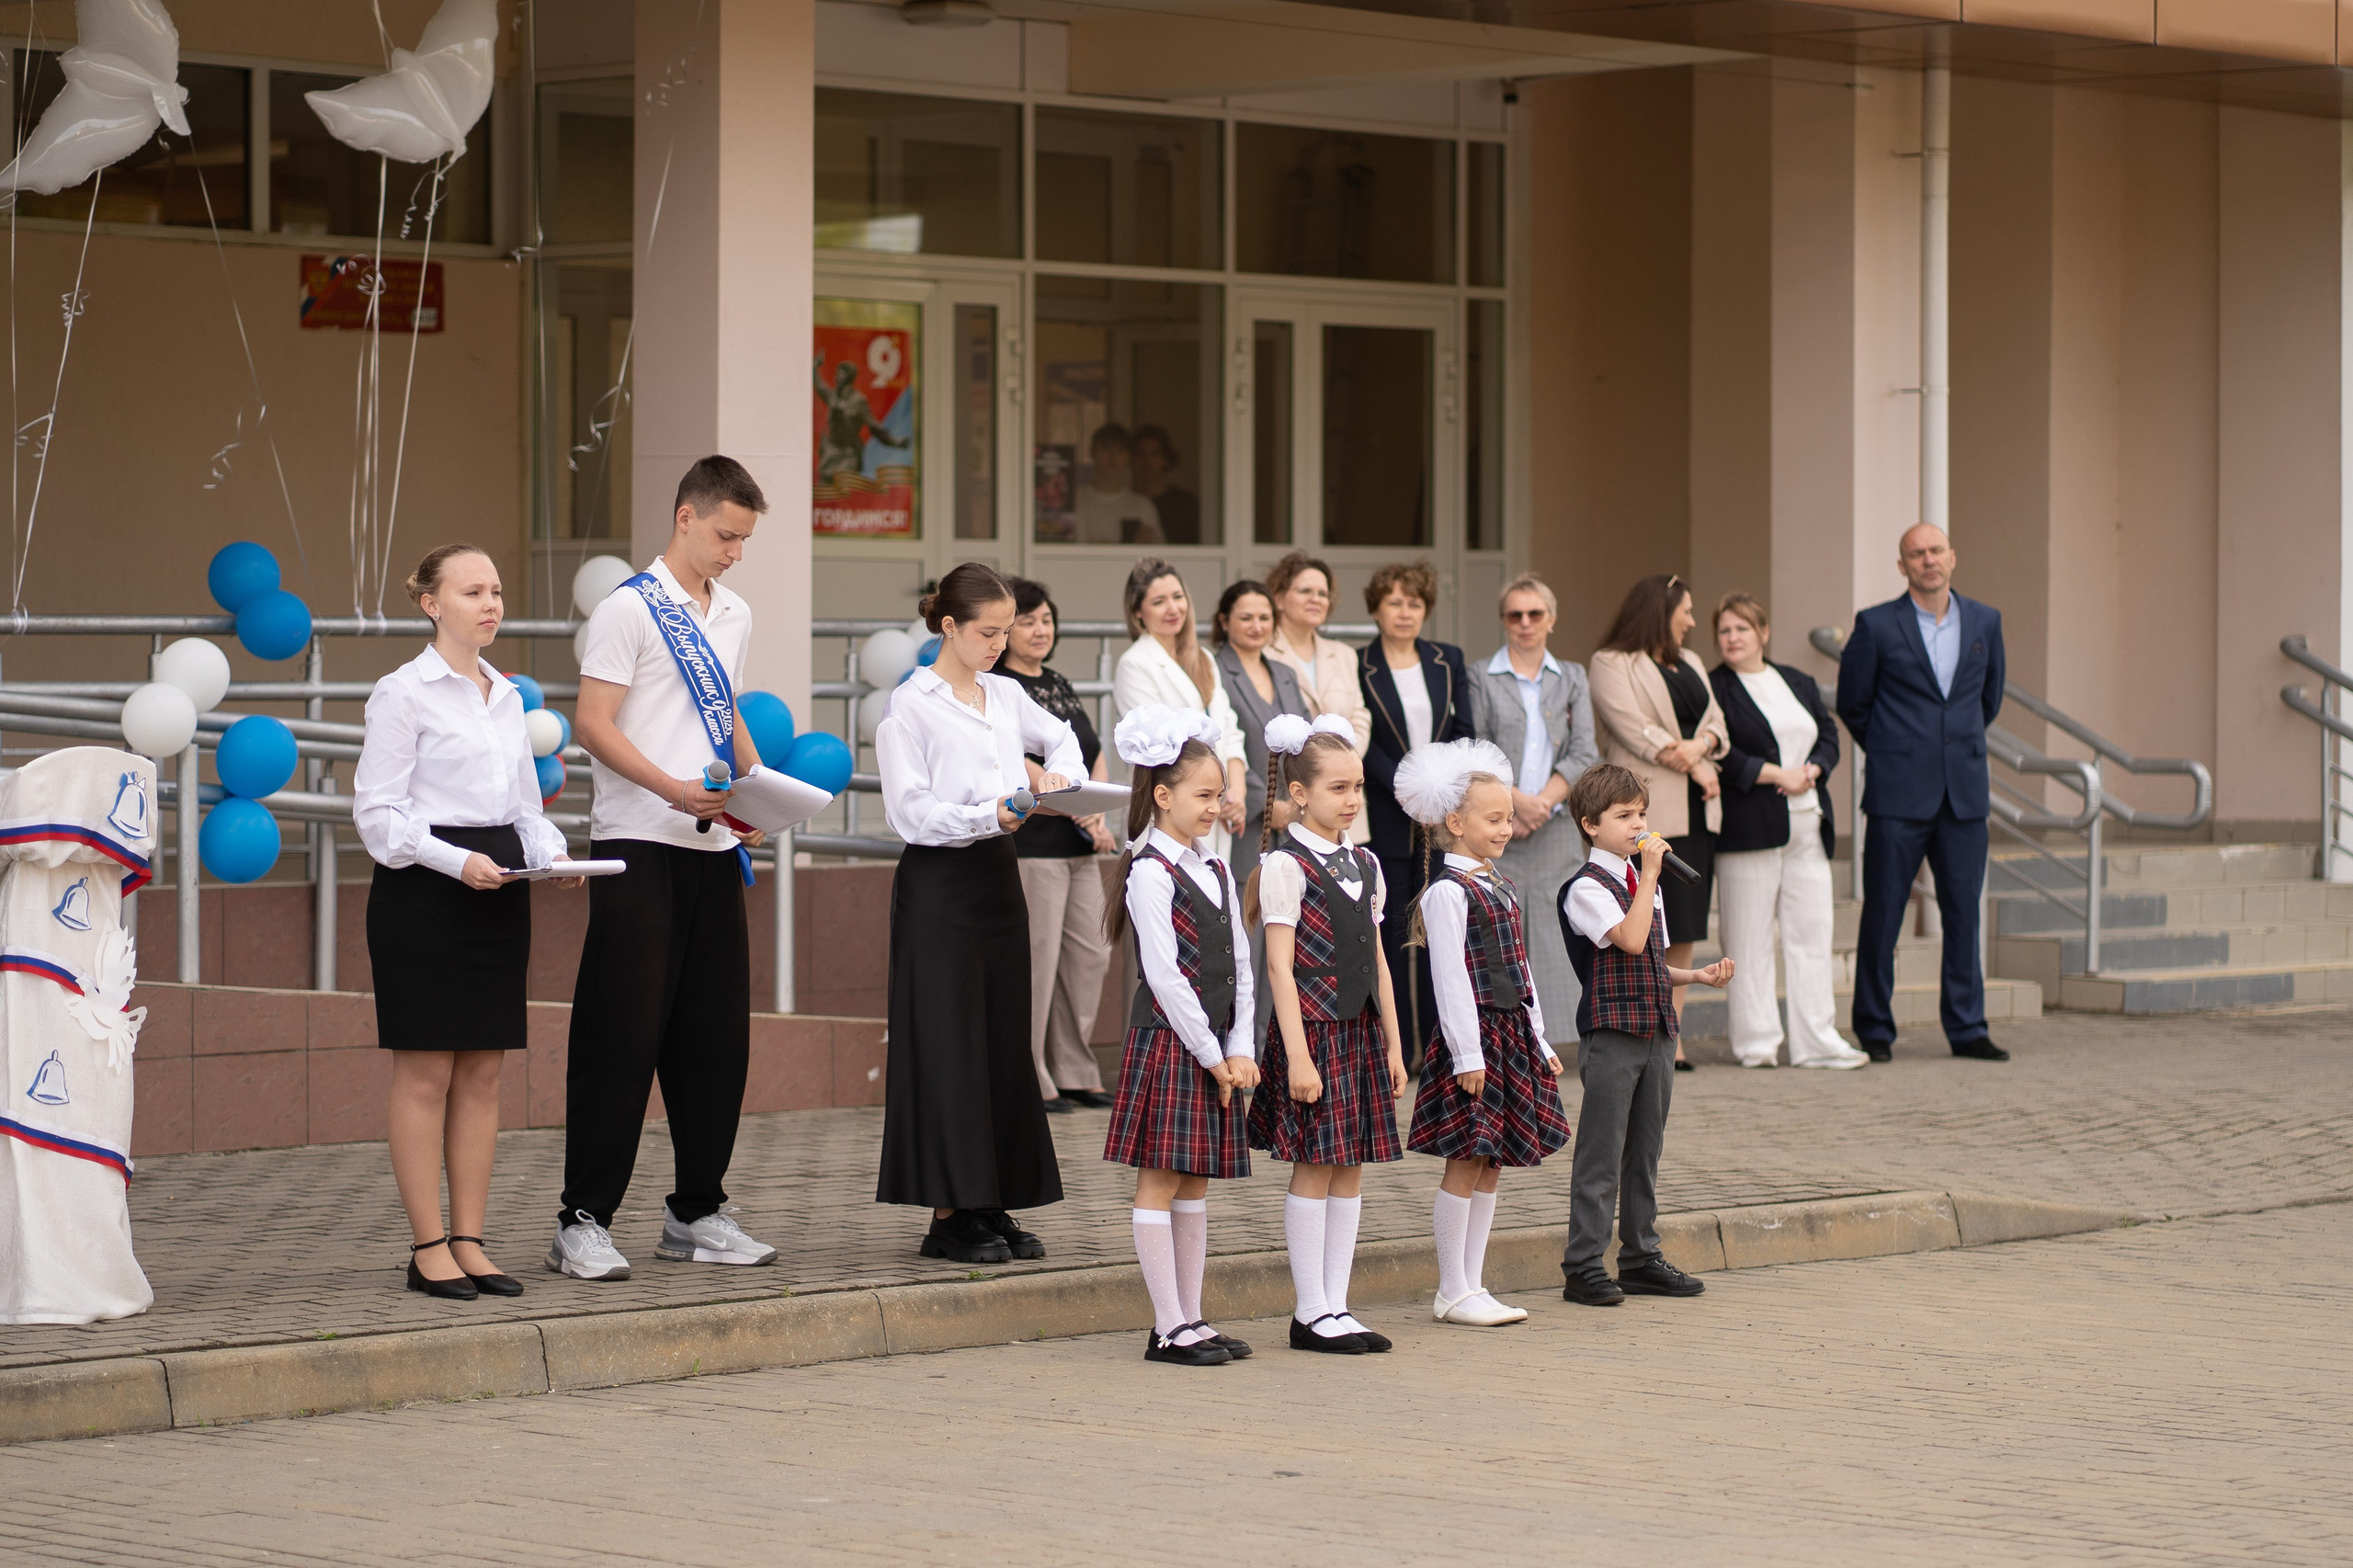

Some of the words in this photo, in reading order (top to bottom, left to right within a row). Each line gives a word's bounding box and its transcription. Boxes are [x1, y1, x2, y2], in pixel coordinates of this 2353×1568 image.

[866, 334, 903, 390] 9
[657, 607, 720, 701] Выпускник
[699, 696, 727, 711] 9
[702, 710, 724, 746] класса
